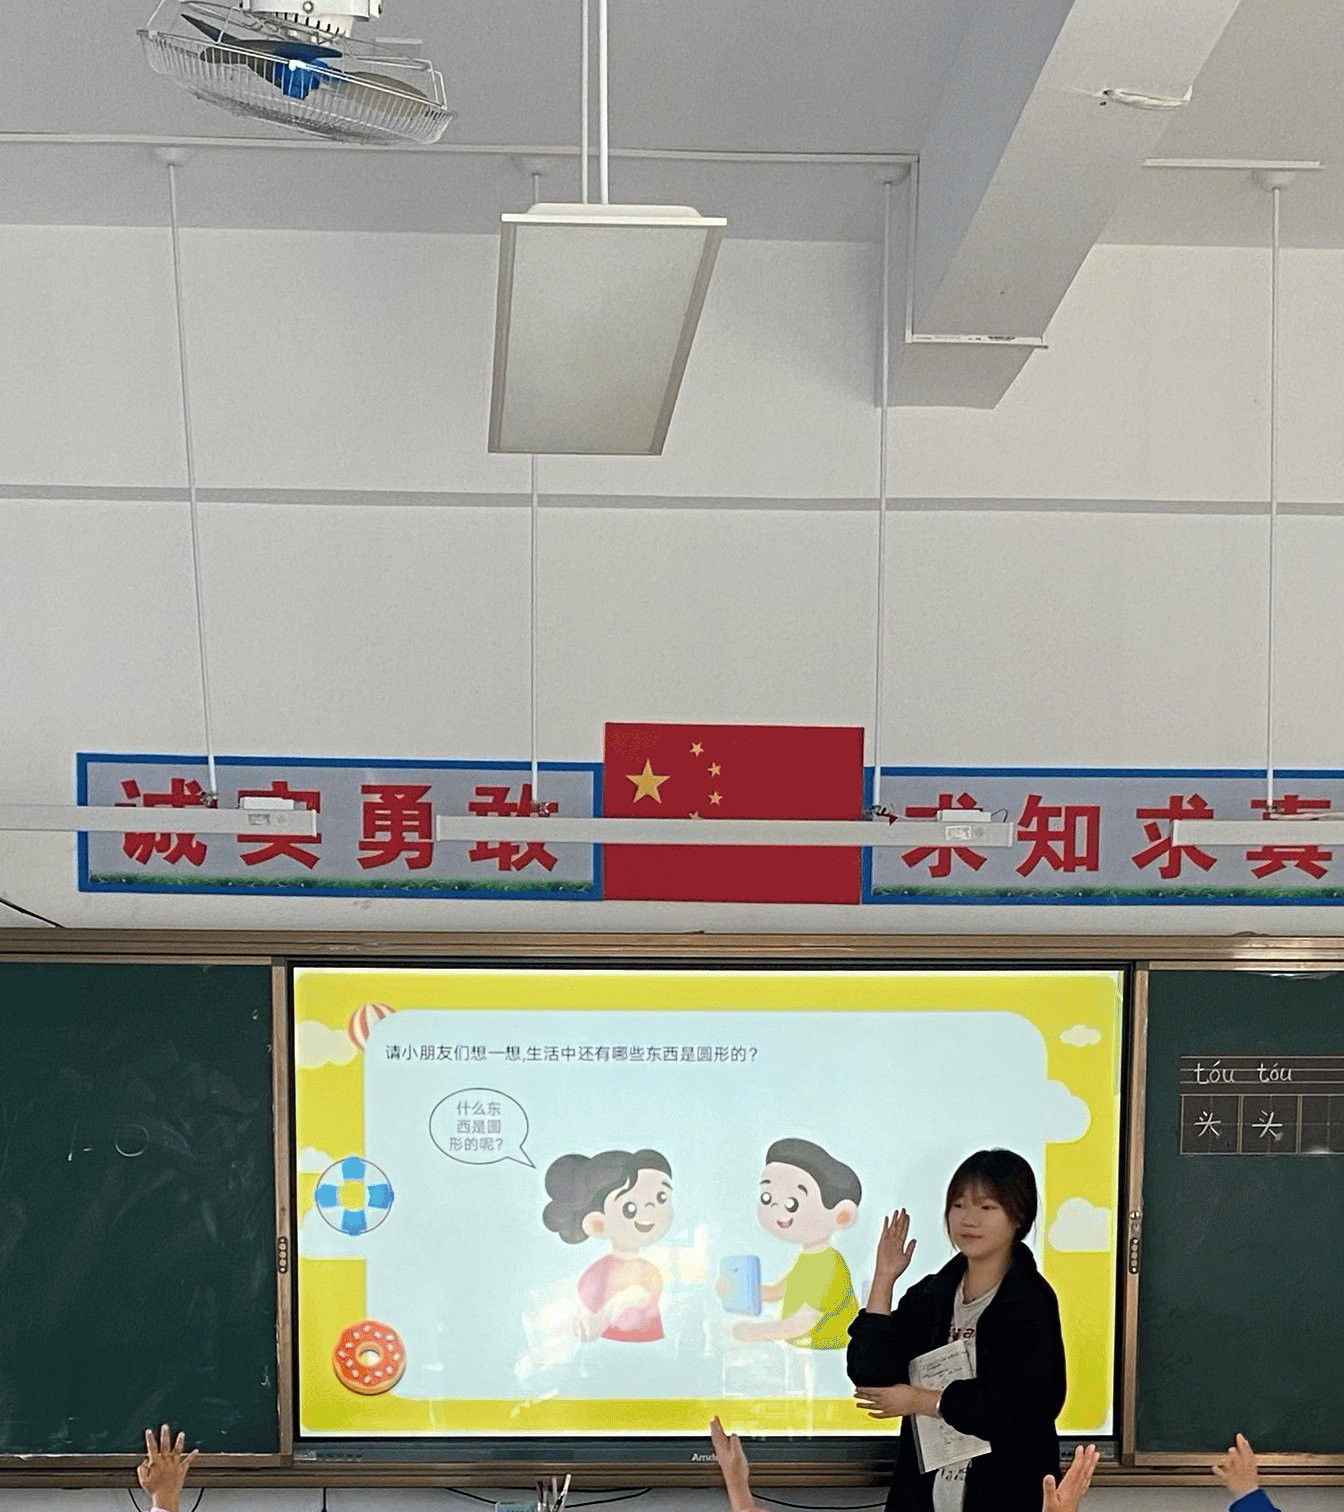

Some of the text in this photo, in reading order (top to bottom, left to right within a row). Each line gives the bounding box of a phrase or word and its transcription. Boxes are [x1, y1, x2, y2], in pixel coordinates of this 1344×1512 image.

[114, 777, 559, 872] 诚实勇敢
[901, 792, 1334, 880] 求知求真
[456, 1101, 501, 1116] 什么东
[456, 1119, 501, 1135] 西是圆
[1193, 1110, 1284, 1139] 头 头
[449, 1137, 504, 1152] 形的呢？
